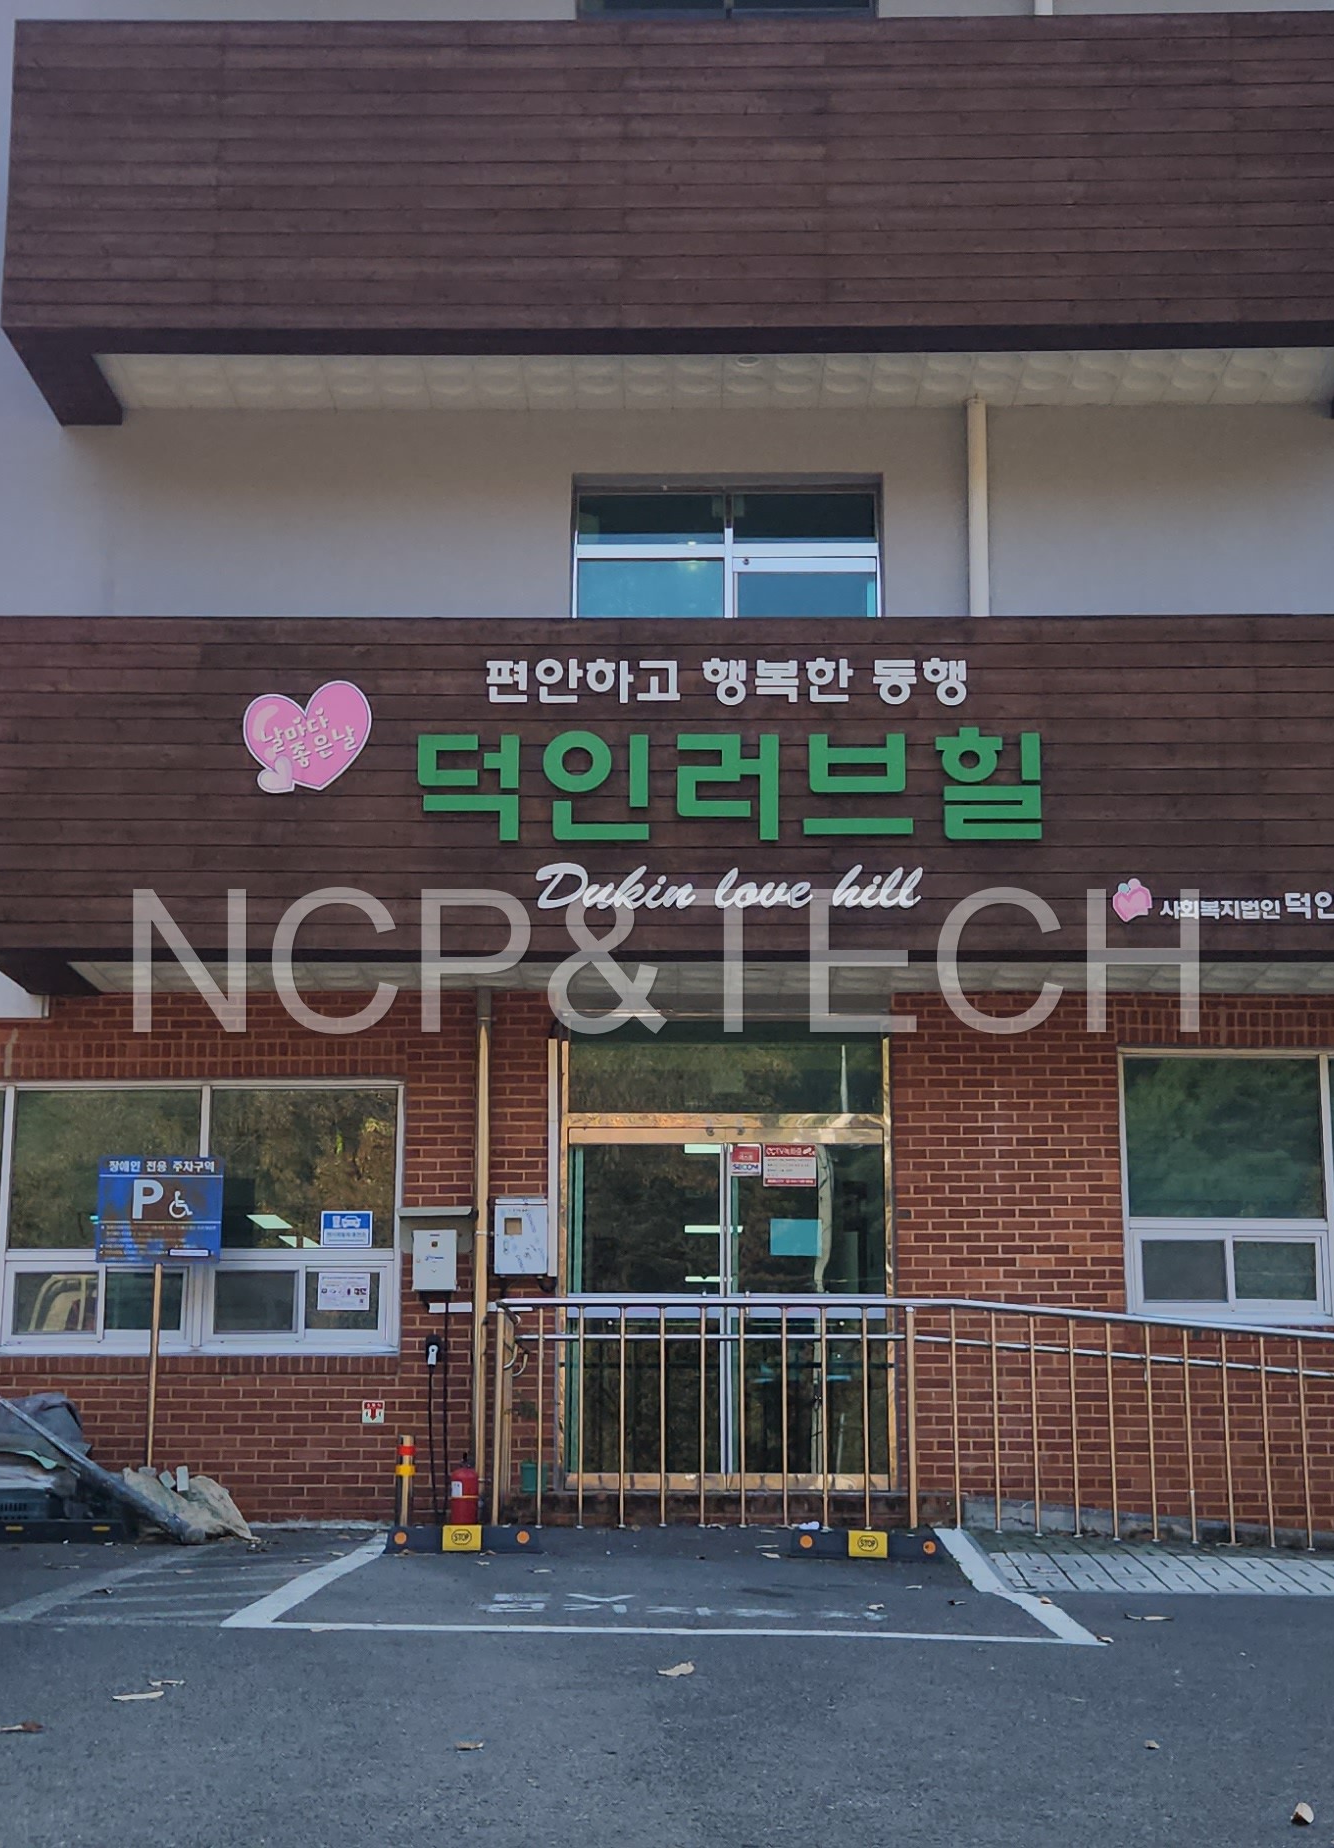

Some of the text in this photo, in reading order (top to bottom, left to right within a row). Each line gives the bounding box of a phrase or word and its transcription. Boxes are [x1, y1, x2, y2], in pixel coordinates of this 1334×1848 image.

[486, 657, 967, 707] 편안하고 행복한 동행
[260, 707, 329, 753] 날마다
[417, 727, 1043, 841] 덕인러브힐
[535, 862, 924, 910] Dukin love hill
[1159, 899, 1281, 920] 사회복지법인
[109, 1160, 141, 1173] 장애인
[173, 1160, 215, 1173] 주차구역
[132, 1179, 164, 1219] P
[453, 1532, 471, 1542] STOP
